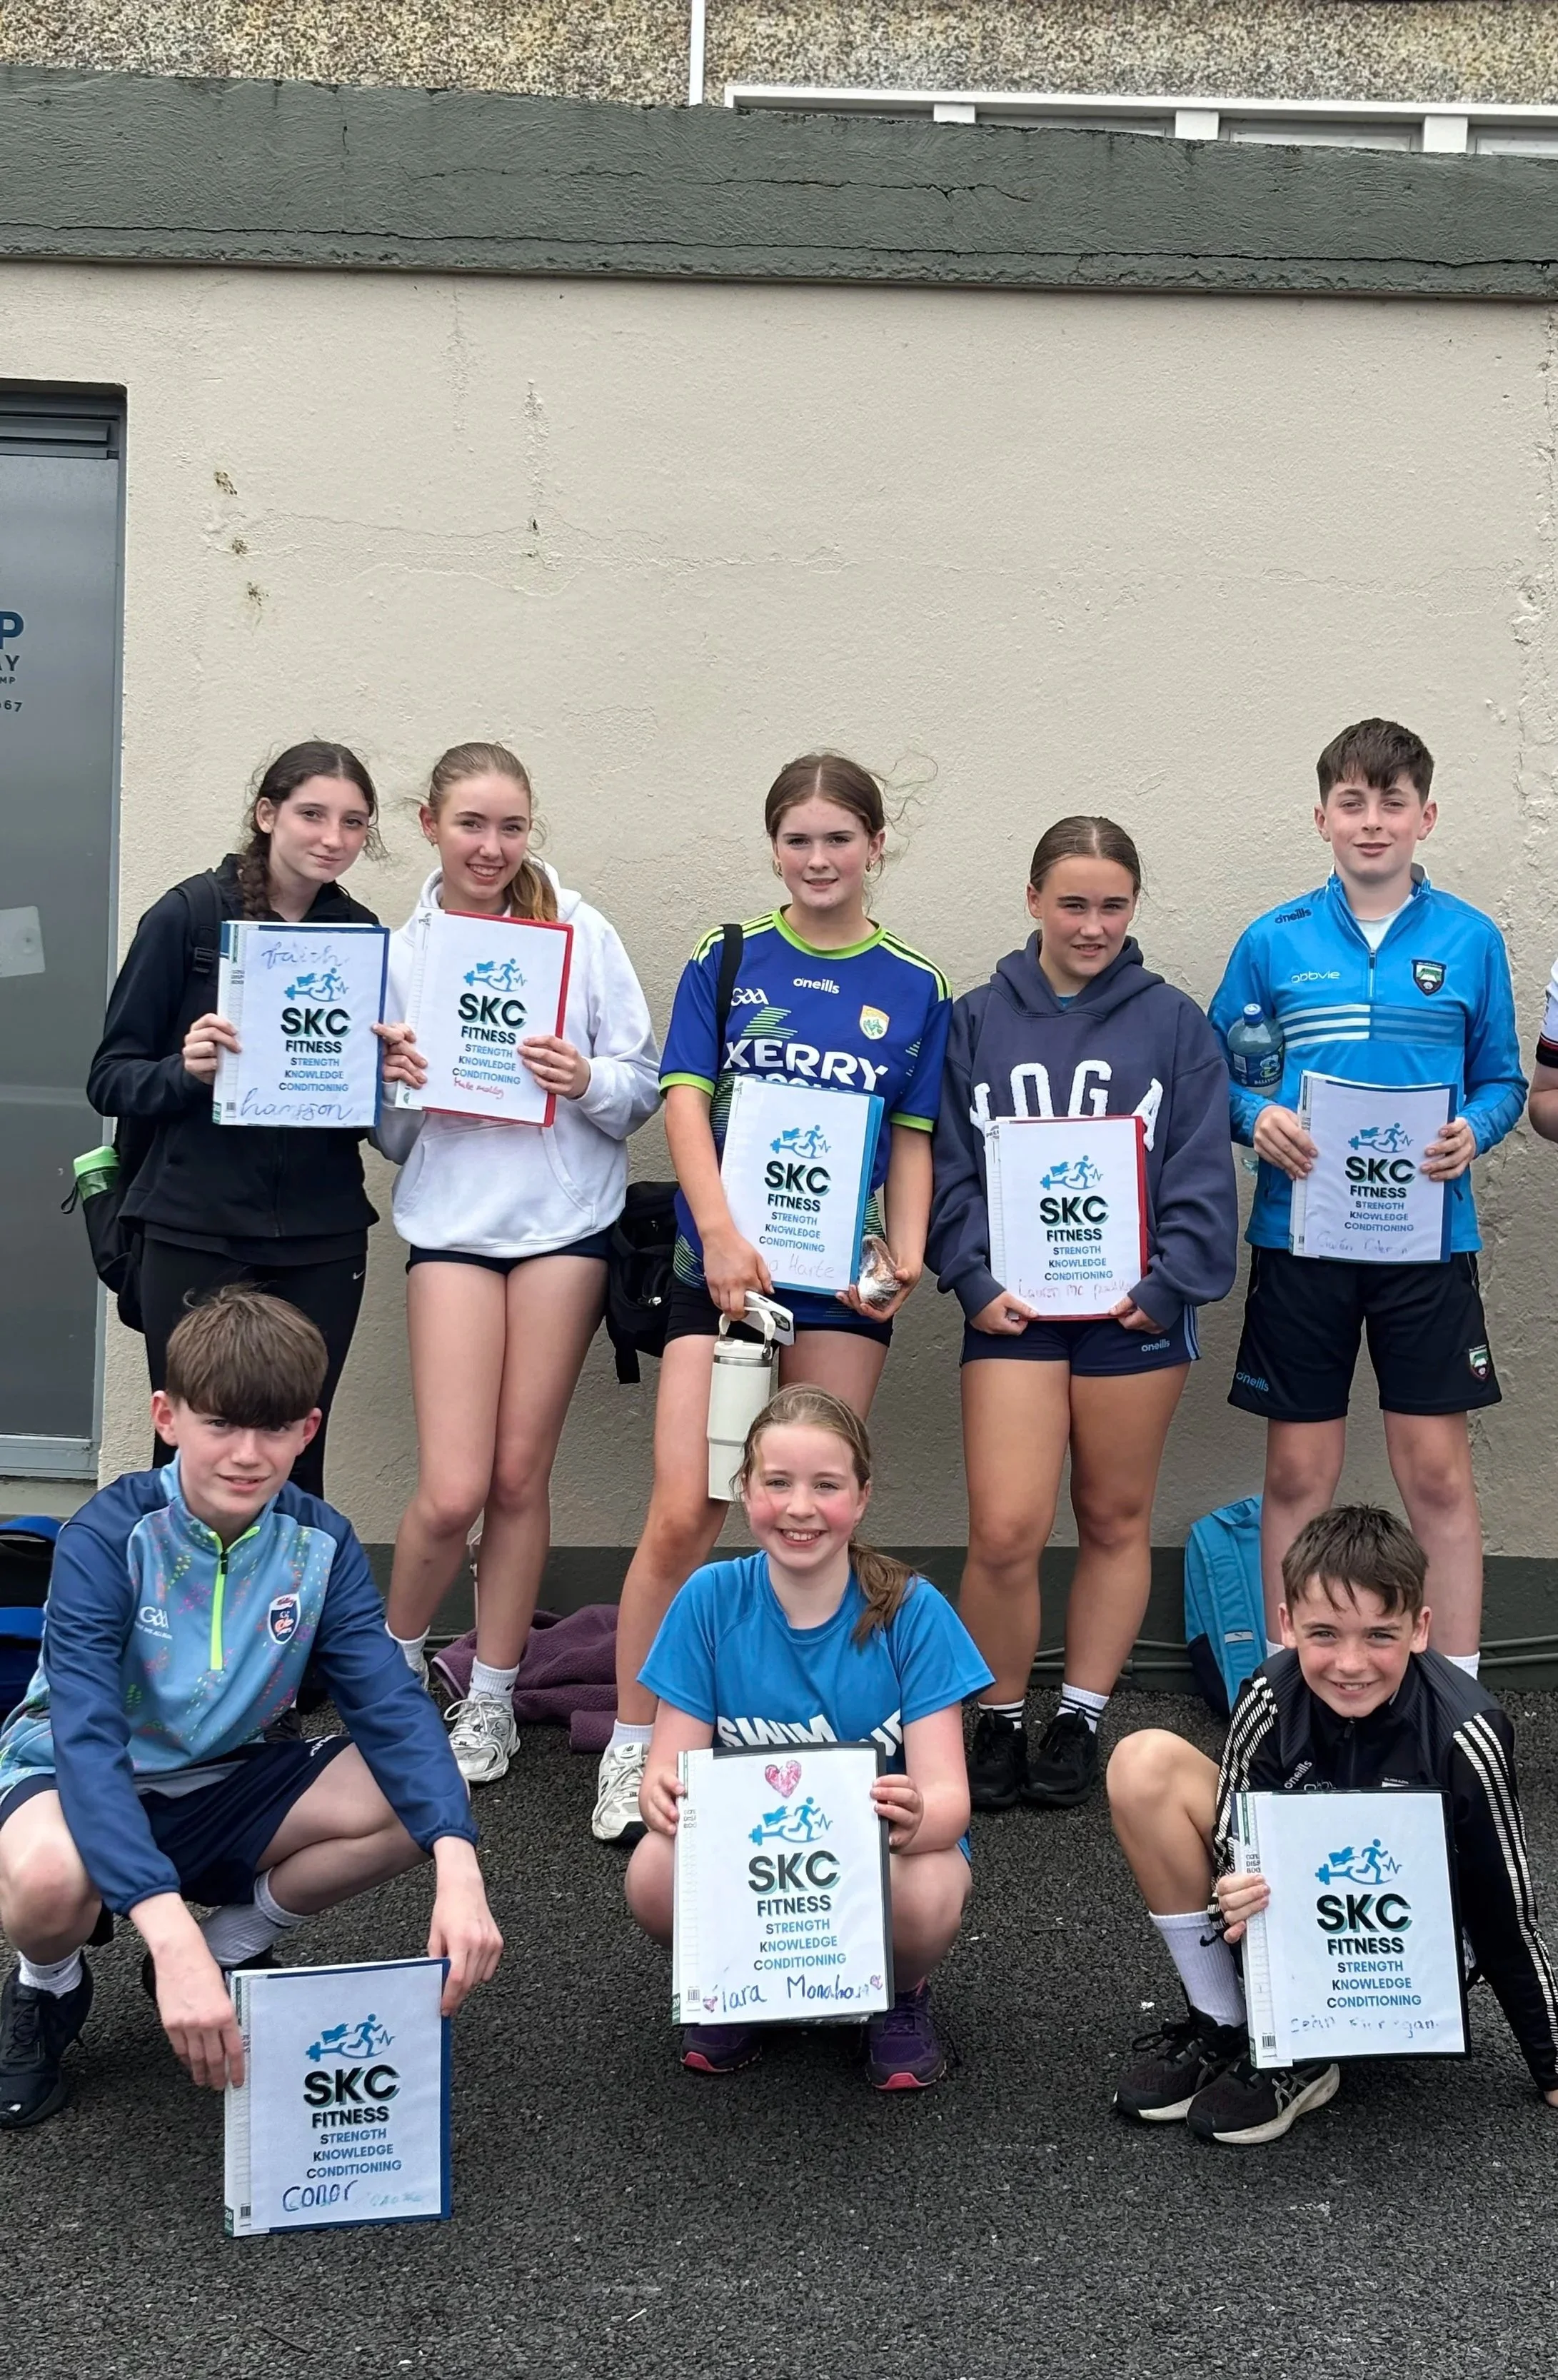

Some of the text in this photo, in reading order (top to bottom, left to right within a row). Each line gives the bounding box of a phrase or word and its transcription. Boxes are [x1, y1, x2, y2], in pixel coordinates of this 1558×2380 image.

[1291, 971, 1340, 983] abbvie
[458, 993, 527, 1028] SKC
[281, 1008, 352, 1037] SKC
[461, 1026, 516, 1045] FITNESS
[286, 1040, 342, 1053] FITNESS
[465, 1044, 513, 1058] STRENGTH
[291, 1058, 339, 1066] STRENGTH
[459, 1055, 516, 1071] KNOWLEDGE
[284, 1070, 343, 1079] KNOWLEDGE
[453, 1068, 521, 1085] CONDITIONING
[279, 1083, 348, 1092] CONDITIONING
[1345, 1156, 1416, 1184] SKC
[765, 1161, 831, 1196] SKC
[1350, 1185, 1407, 1199] FITNESS
[768, 1193, 821, 1212] FITNESS
[1040, 1195, 1109, 1226] SKC
[1356, 1200, 1404, 1210] STRENGTH
[771, 1212, 818, 1226] STRENGTH
[1350, 1212, 1409, 1222] KNOWLEDGE
[765, 1224, 820, 1238] KNOWLEDGE
[1047, 1228, 1102, 1242] FITNESS
[1345, 1222, 1414, 1232] CONDITIONING
[759, 1236, 825, 1252] CONDITIONING
[1053, 1245, 1101, 1256] STRENGTH
[1049, 1257, 1107, 1268] KNOWLEDGE
[1045, 1270, 1113, 1281] CONDITIONING
[748, 1849, 841, 1895] SKC
[757, 1894, 832, 1917] FITNESS
[1316, 1892, 1413, 1934] SKC
[766, 1919, 830, 1935] STRENGTH
[760, 1935, 838, 1953] KNOWLEDGE
[1327, 1937, 1404, 1956] FITNESS
[753, 1953, 846, 1971] CONDITIONING
[1337, 1960, 1403, 1973] STRENGTH
[1332, 1977, 1411, 1990] KNOWLEDGE
[1327, 1994, 1421, 2008] CONDITIONING
[303, 2064, 401, 2108] SKC
[312, 2106, 390, 2129] FITNESS
[320, 2128, 386, 2144] STRENGTH
[313, 2144, 393, 2162] KNOWLEDGE
[306, 2160, 402, 2179] CONDITIONING
